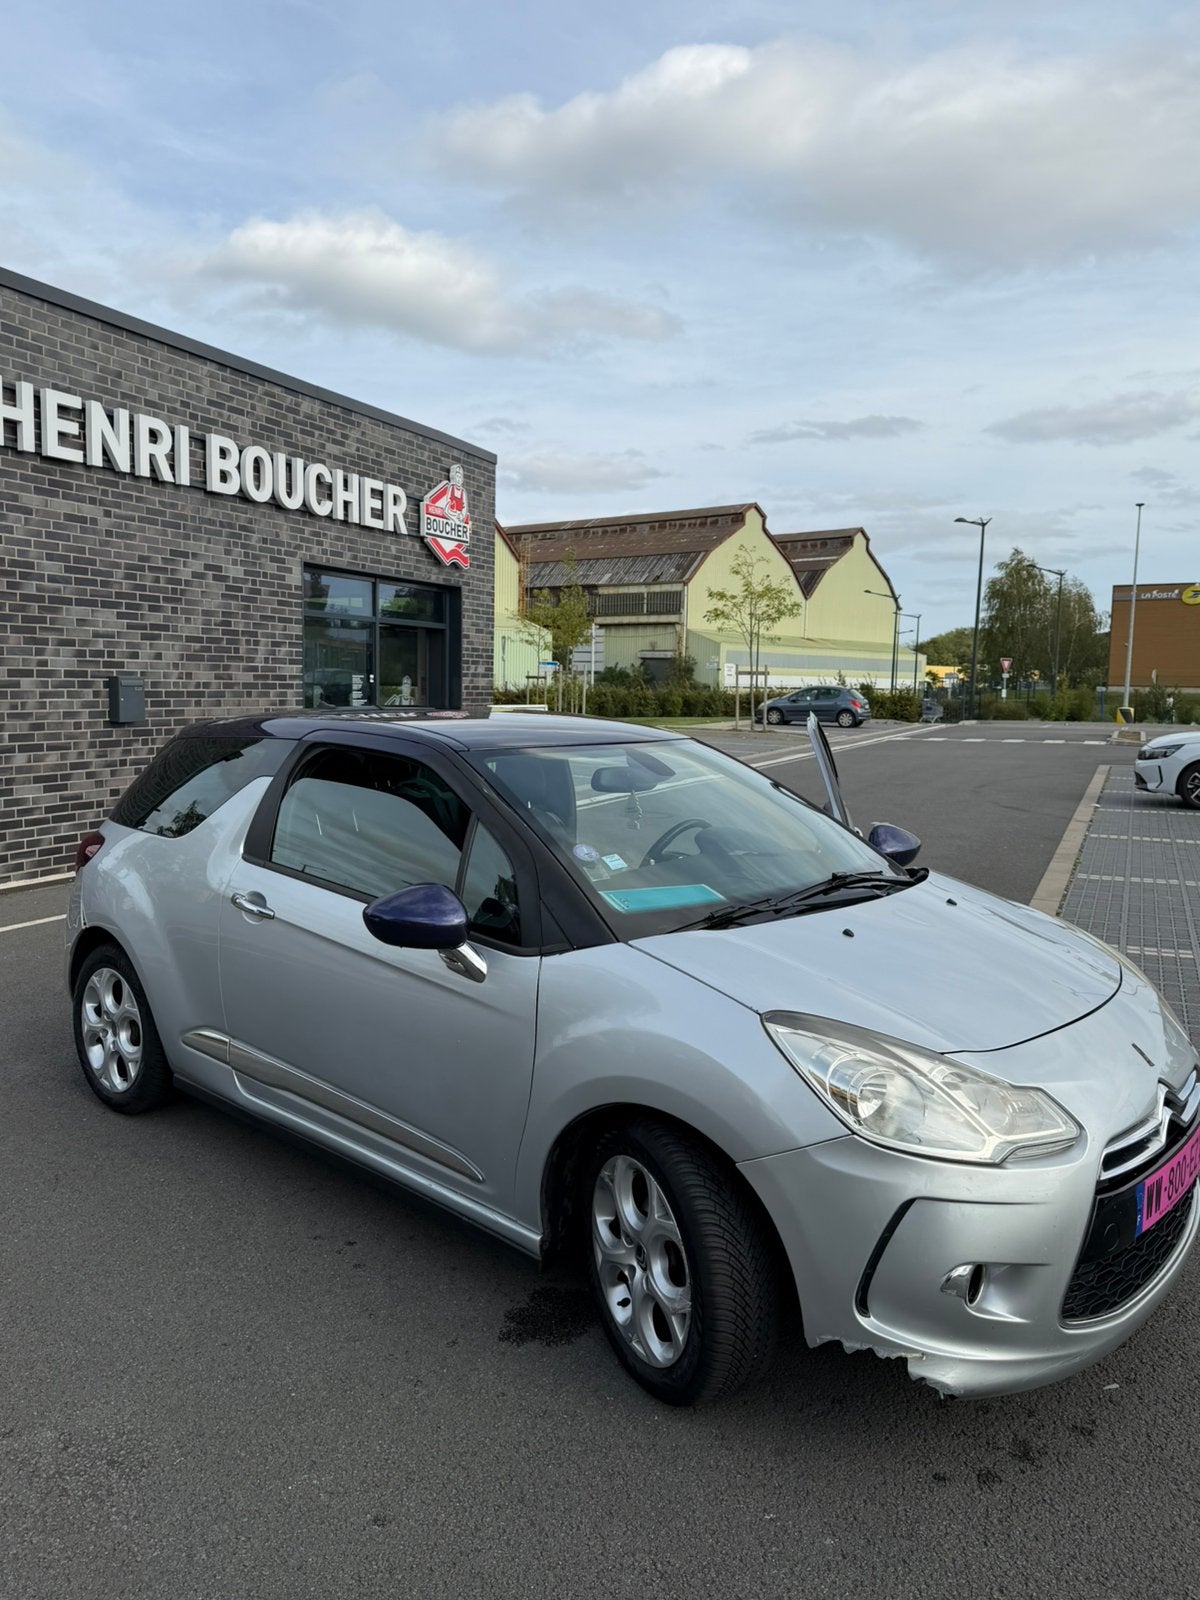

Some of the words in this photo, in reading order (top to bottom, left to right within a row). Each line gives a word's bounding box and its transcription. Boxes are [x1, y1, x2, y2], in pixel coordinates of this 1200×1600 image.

[0, 375, 191, 486] HENRI
[205, 432, 408, 535] BOUCHER
[427, 517, 468, 539] BOUCHER
